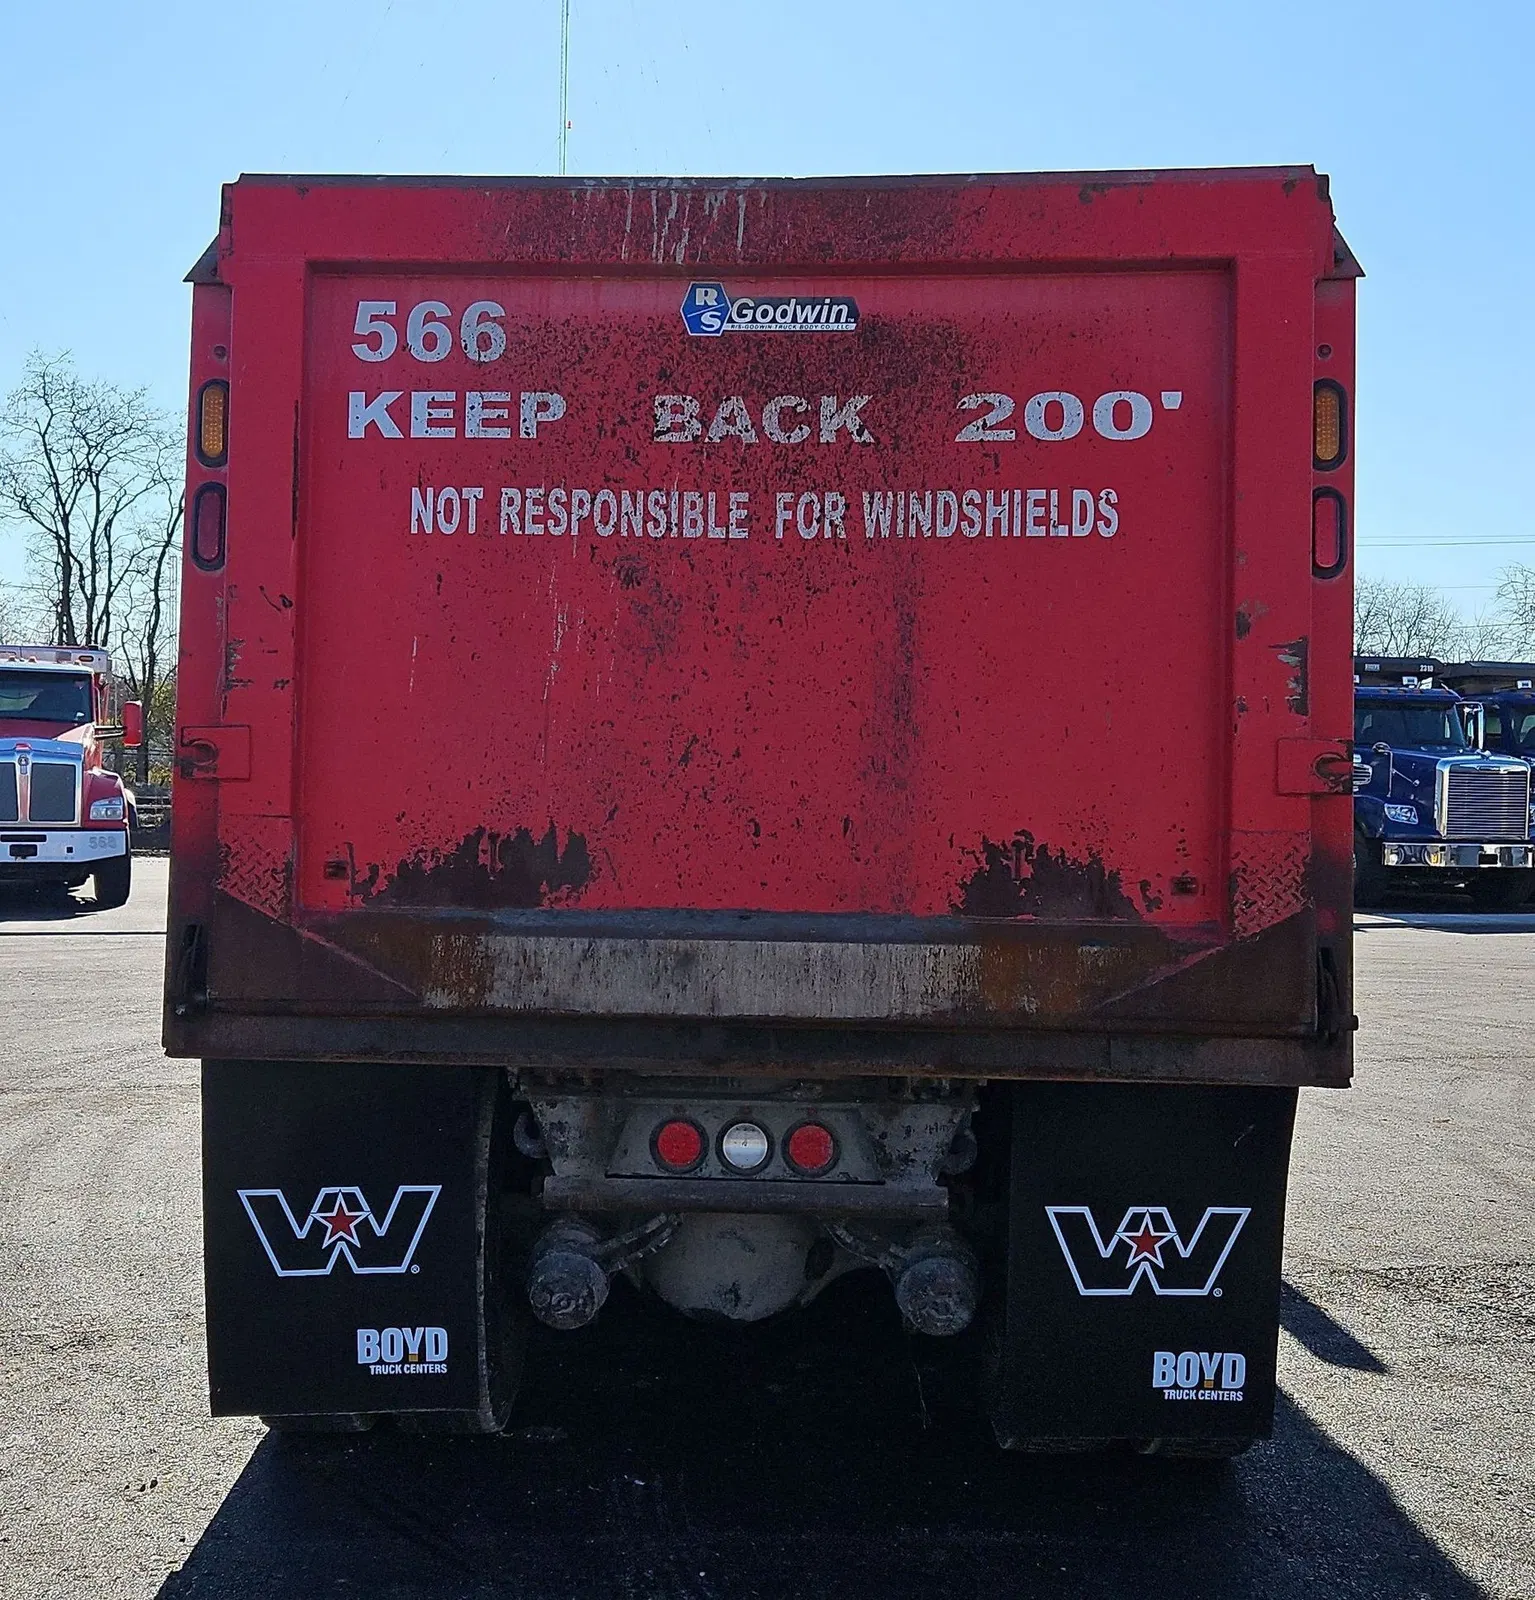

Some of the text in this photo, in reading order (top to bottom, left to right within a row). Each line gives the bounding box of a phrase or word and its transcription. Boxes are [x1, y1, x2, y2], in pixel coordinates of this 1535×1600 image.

[695, 287, 718, 306] R
[731, 298, 849, 323] Godwin
[350, 300, 507, 363] 566
[700, 311, 722, 332] S
[347, 390, 1183, 444] KEEP BACK 200'
[410, 486, 1120, 539] NOT RESPONSIBLE FOR WINDSHIELDS
[357, 1327, 448, 1364] BOYD
[369, 1363, 448, 1375] TRUCK CENTERS
[1152, 1351, 1246, 1389] BOYD
[1163, 1389, 1244, 1402] TRUCK CENTERS
